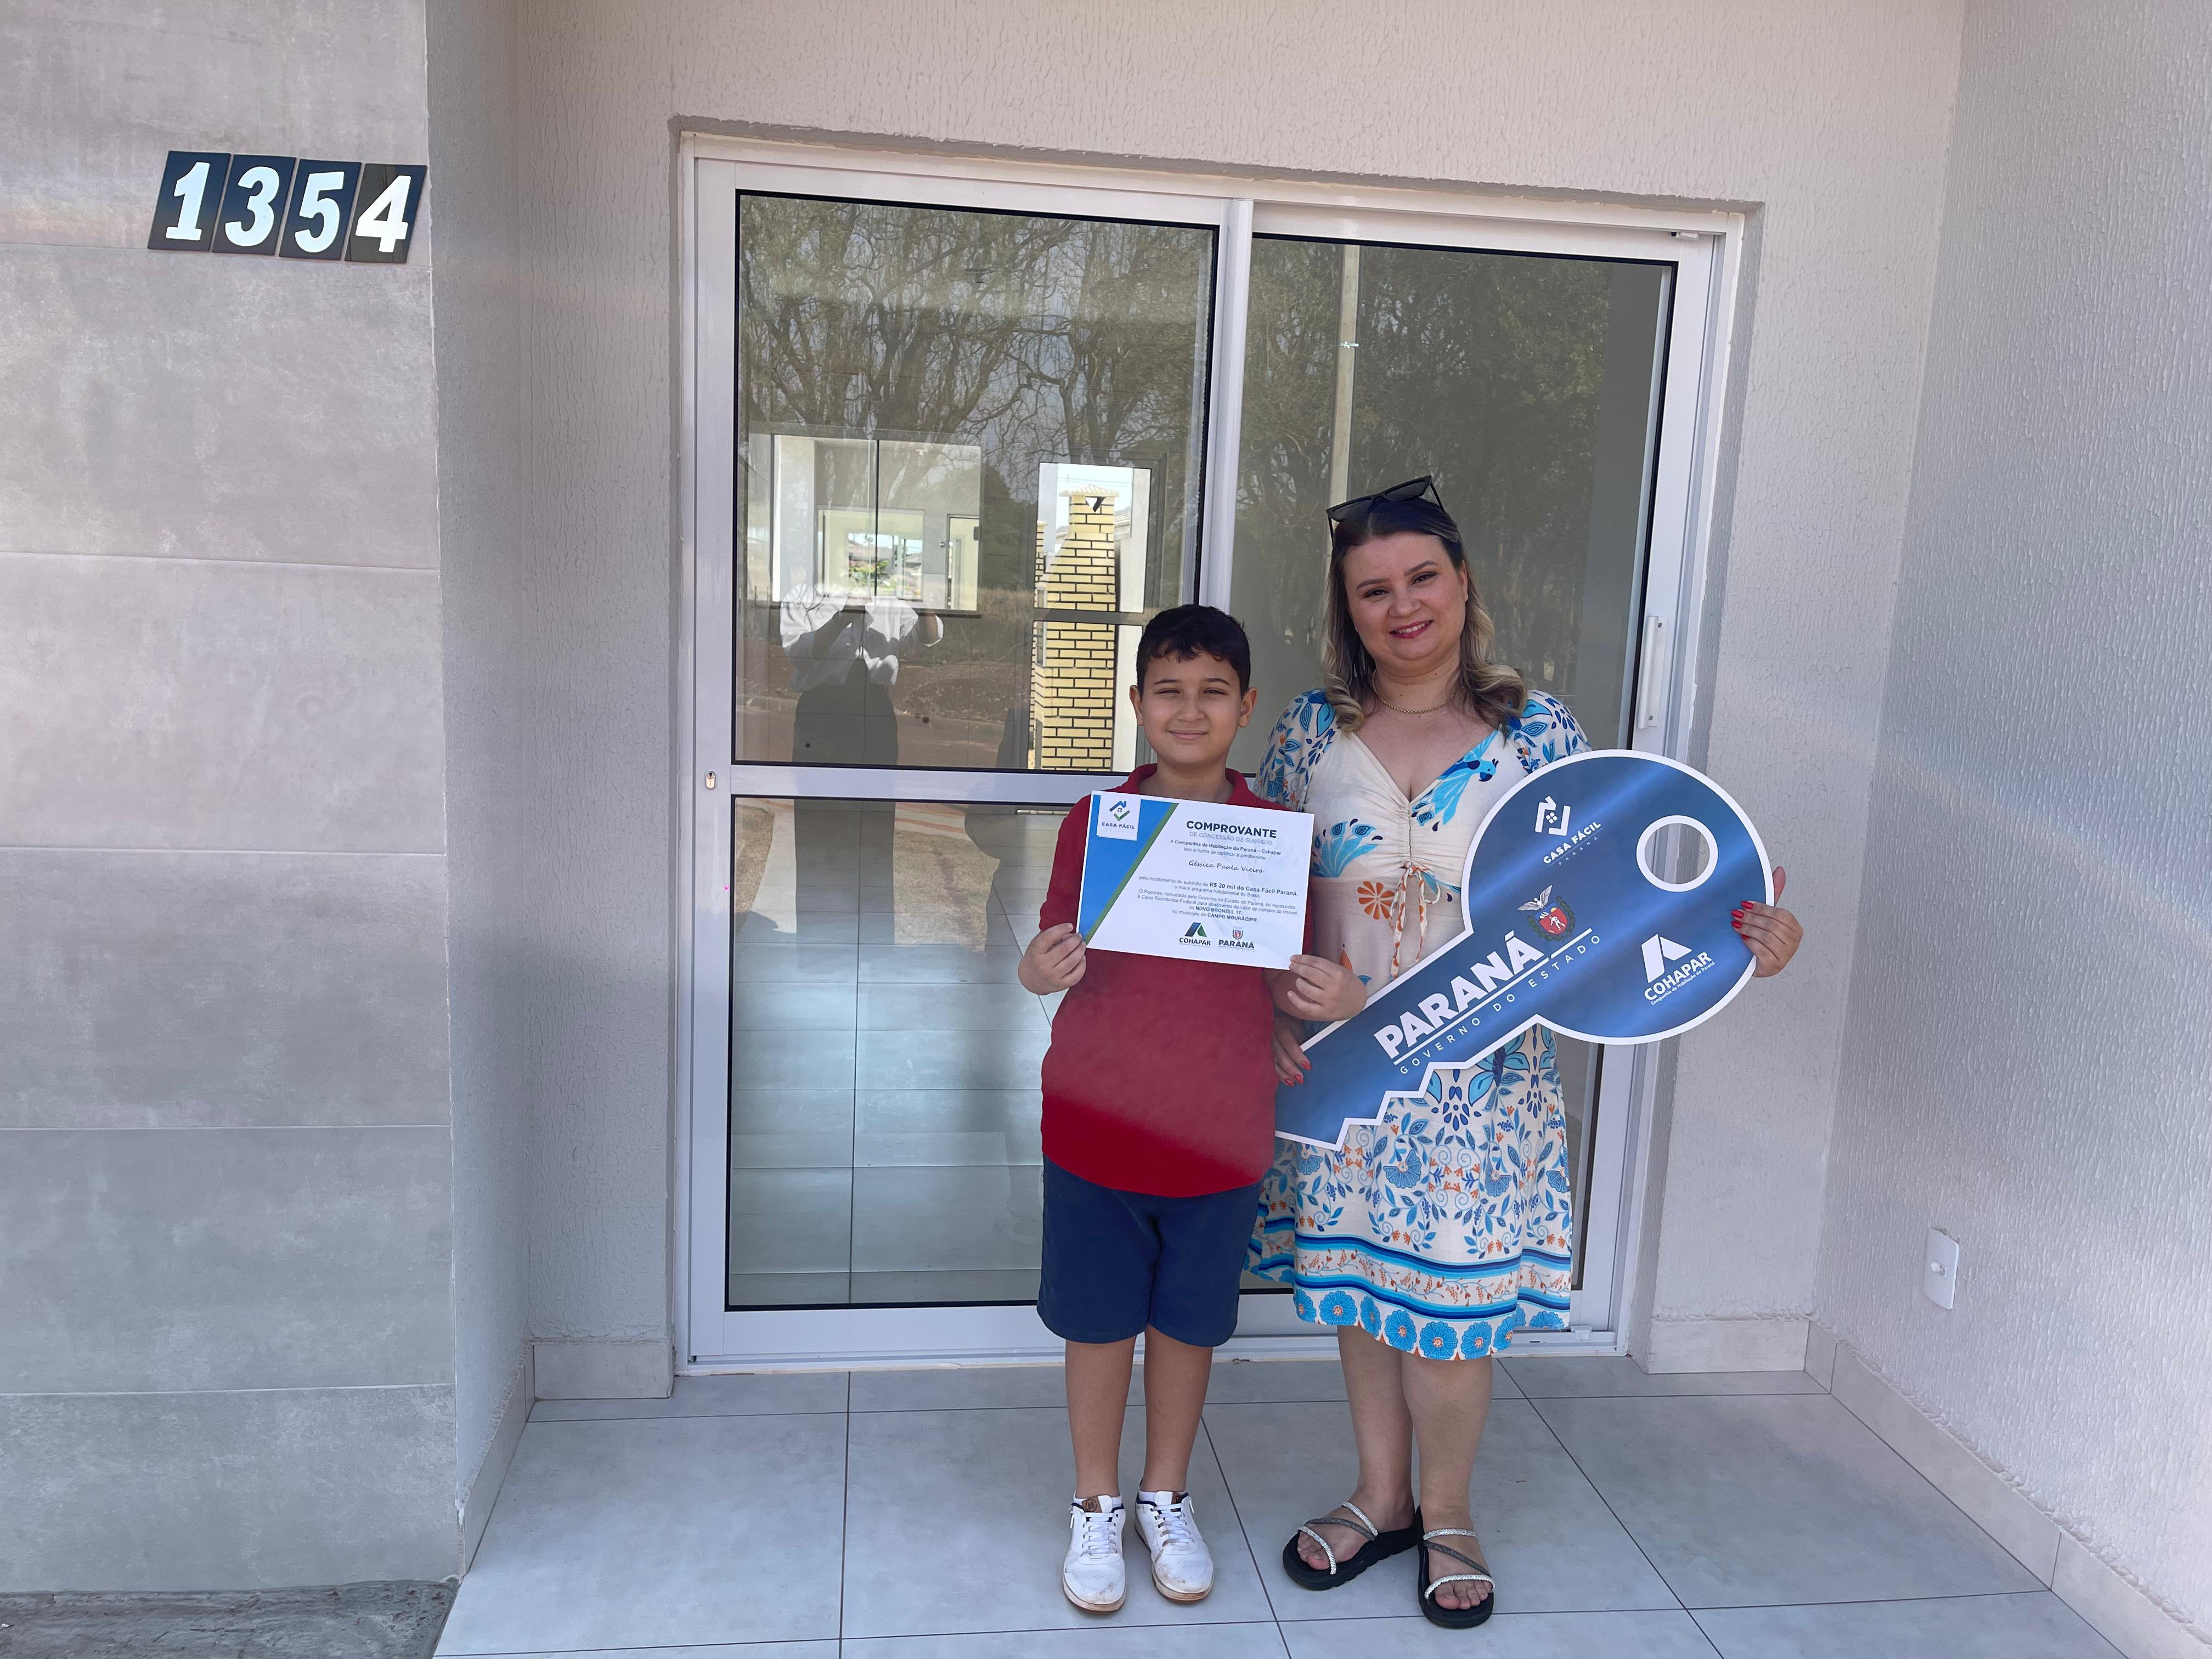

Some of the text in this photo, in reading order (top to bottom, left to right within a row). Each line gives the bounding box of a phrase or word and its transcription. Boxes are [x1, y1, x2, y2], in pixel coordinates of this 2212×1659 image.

[165, 161, 412, 254] 1354
[1186, 820, 1277, 838] COMPROVANTE
[1199, 832, 1234, 841] CONCESSÃO
[1245, 837, 1273, 845] SUBSÍDIO
[1543, 822, 1601, 864] CASA FÁCIL
[1241, 865, 1265, 873] Vieira
[1179, 937, 1211, 946] COHAPAR
[1218, 939, 1255, 949] PARANÁ
[1374, 930, 1545, 1059] PARANÁ
[1644, 952, 1712, 1000] COHAPAR
[1651, 990, 1672, 1006] Companhia
[1677, 974, 1696, 989] Habitação
[1701, 961, 1716, 972] Paraná
[1400, 935, 1600, 1075] GOVERNO DO ESTADO
